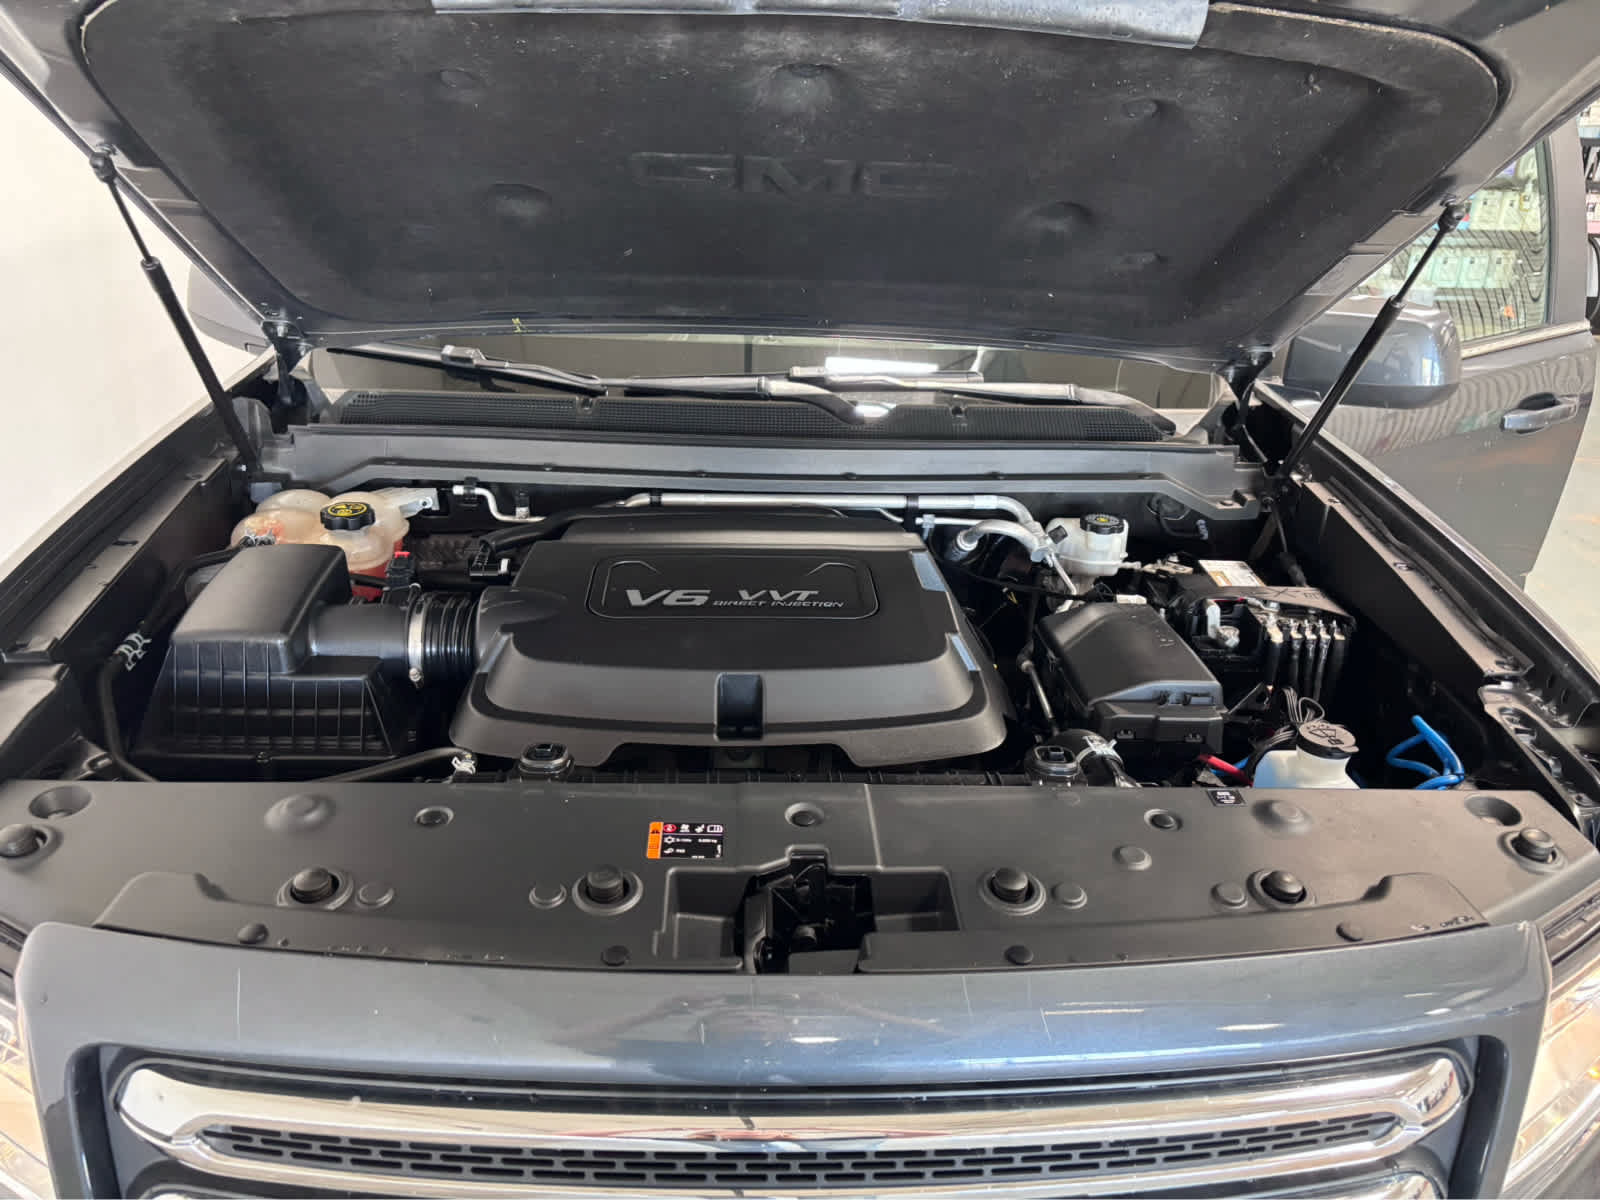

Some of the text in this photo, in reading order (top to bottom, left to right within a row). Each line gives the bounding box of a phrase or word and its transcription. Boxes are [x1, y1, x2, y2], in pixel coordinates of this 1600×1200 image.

[629, 152, 954, 199] GMC
[626, 589, 819, 607] V6 VVT
[771, 600, 845, 608] INJECTION
